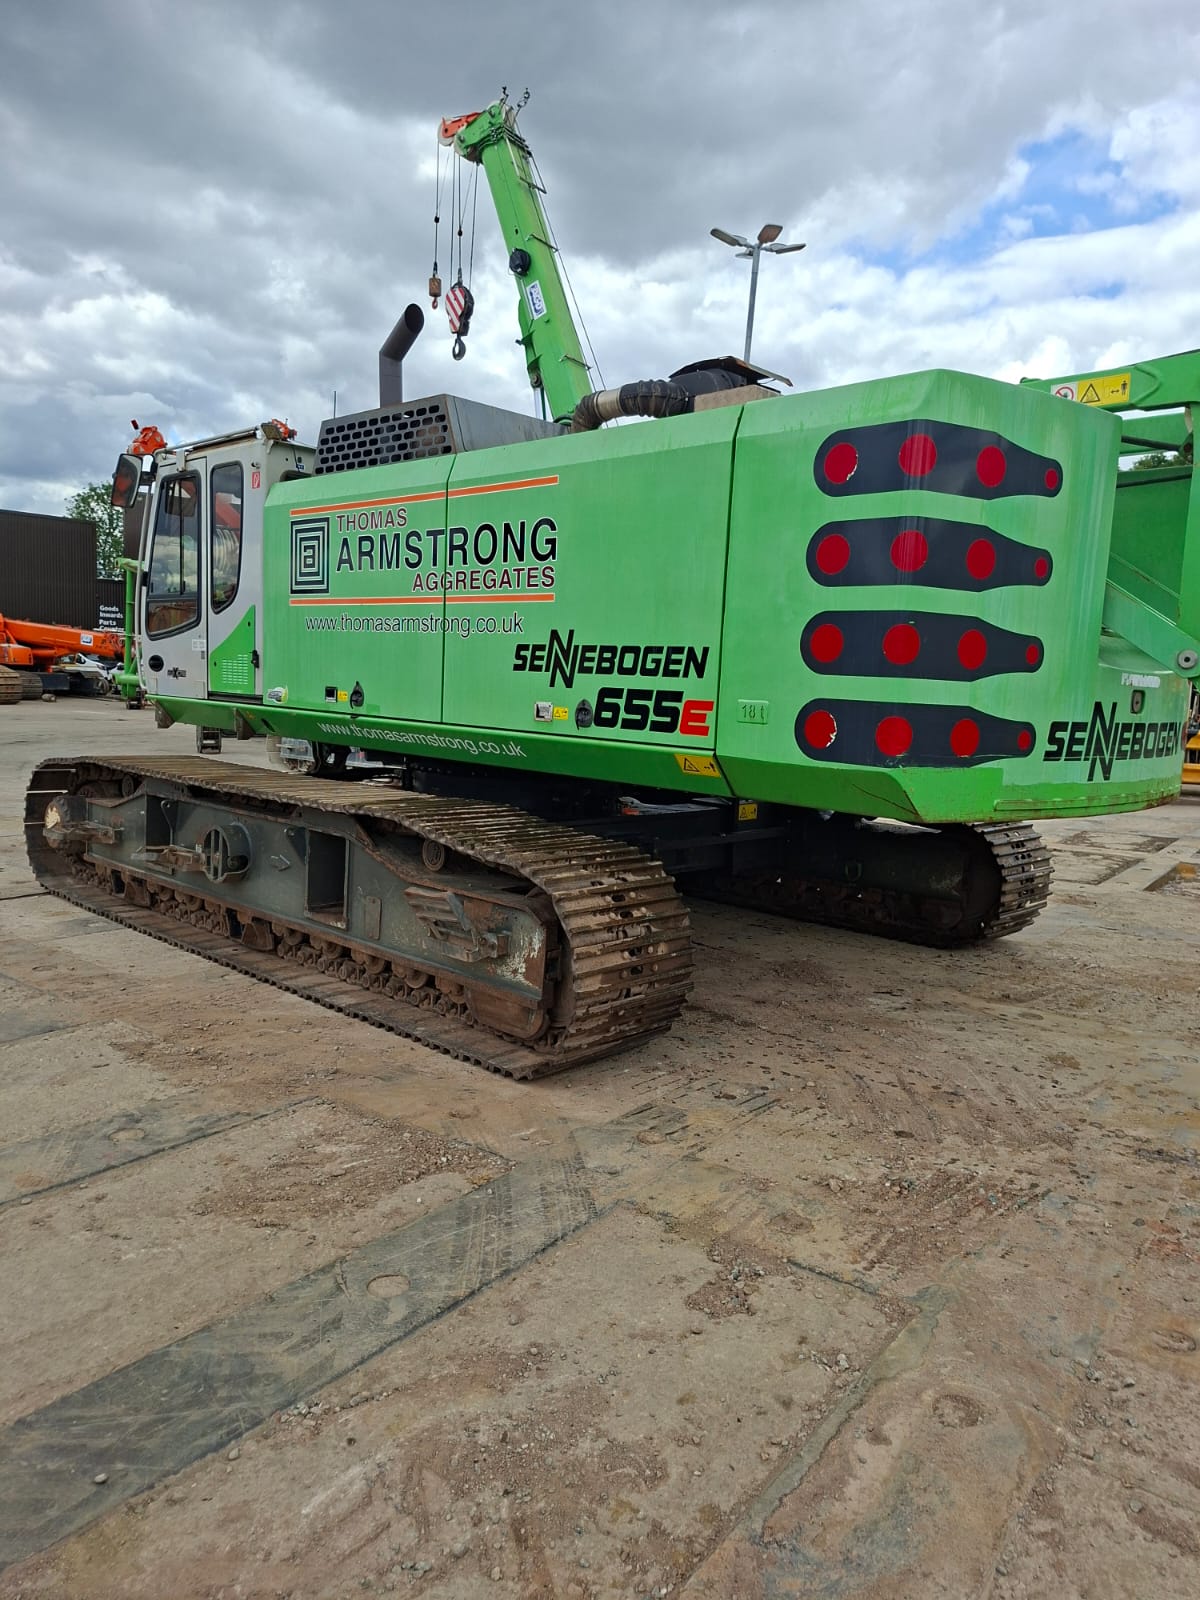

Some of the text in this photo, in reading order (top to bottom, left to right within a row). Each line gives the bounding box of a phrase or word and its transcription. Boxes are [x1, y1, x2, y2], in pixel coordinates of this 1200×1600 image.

[336, 507, 408, 533] THOMAS
[336, 517, 558, 573] ARMSTRONG
[412, 565, 555, 593] AGGREGATES
[305, 611, 524, 638] www.thomasarmstrong.co.uk
[512, 629, 710, 688] SENNEBOGEN
[593, 686, 715, 737] 655E
[317, 722, 526, 758] www.thomasarmstrong.co.uk
[1043, 701, 1181, 782] SENNEBOGEN
